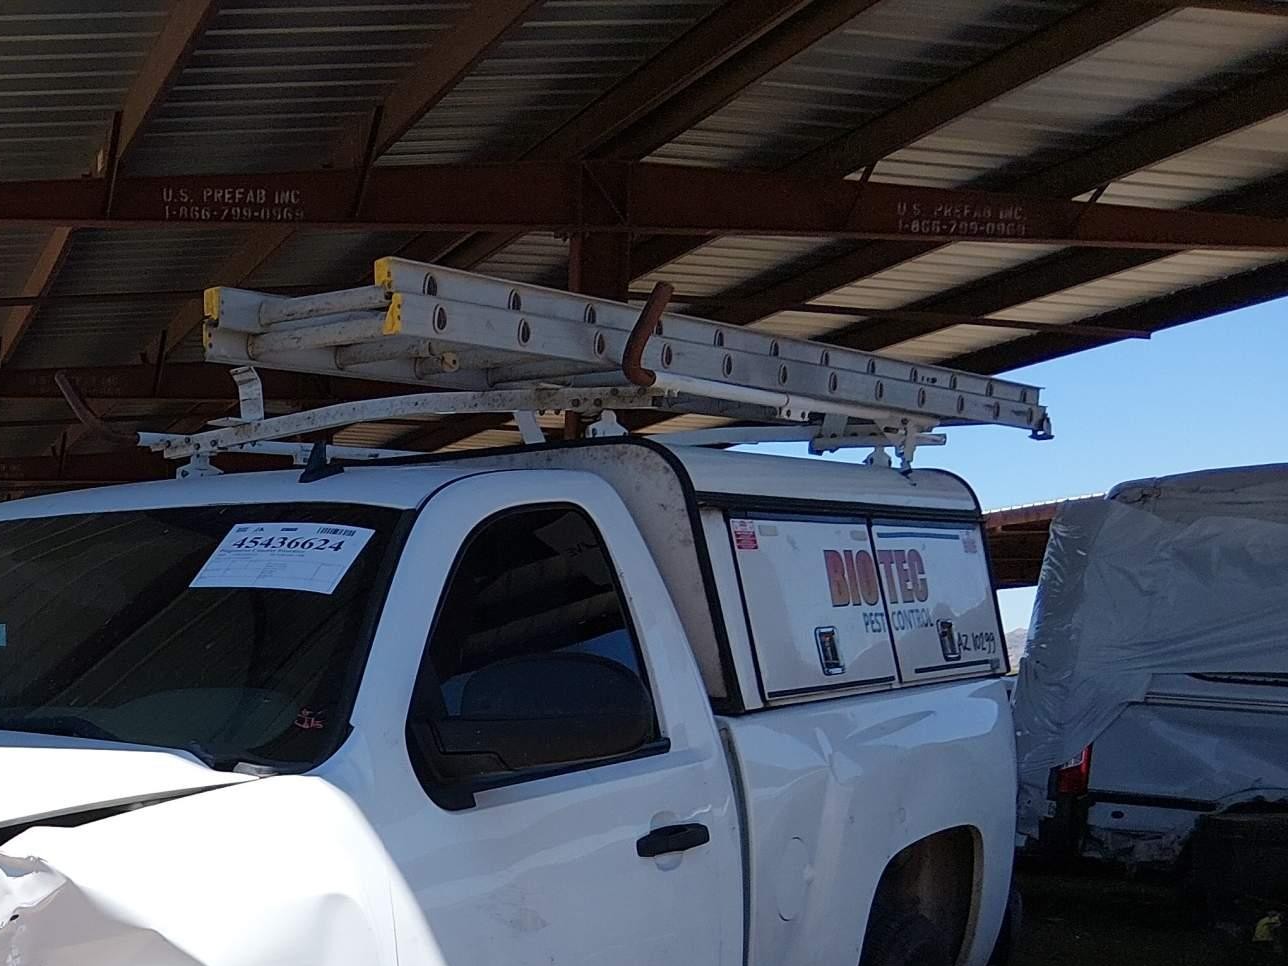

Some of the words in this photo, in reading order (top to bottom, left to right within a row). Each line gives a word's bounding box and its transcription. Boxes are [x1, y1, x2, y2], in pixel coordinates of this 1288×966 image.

[203, 187, 267, 204] PREFAB
[232, 536, 345, 552] 45436624
[862, 611, 887, 633] PEST
[891, 608, 934, 631] CONTROL
